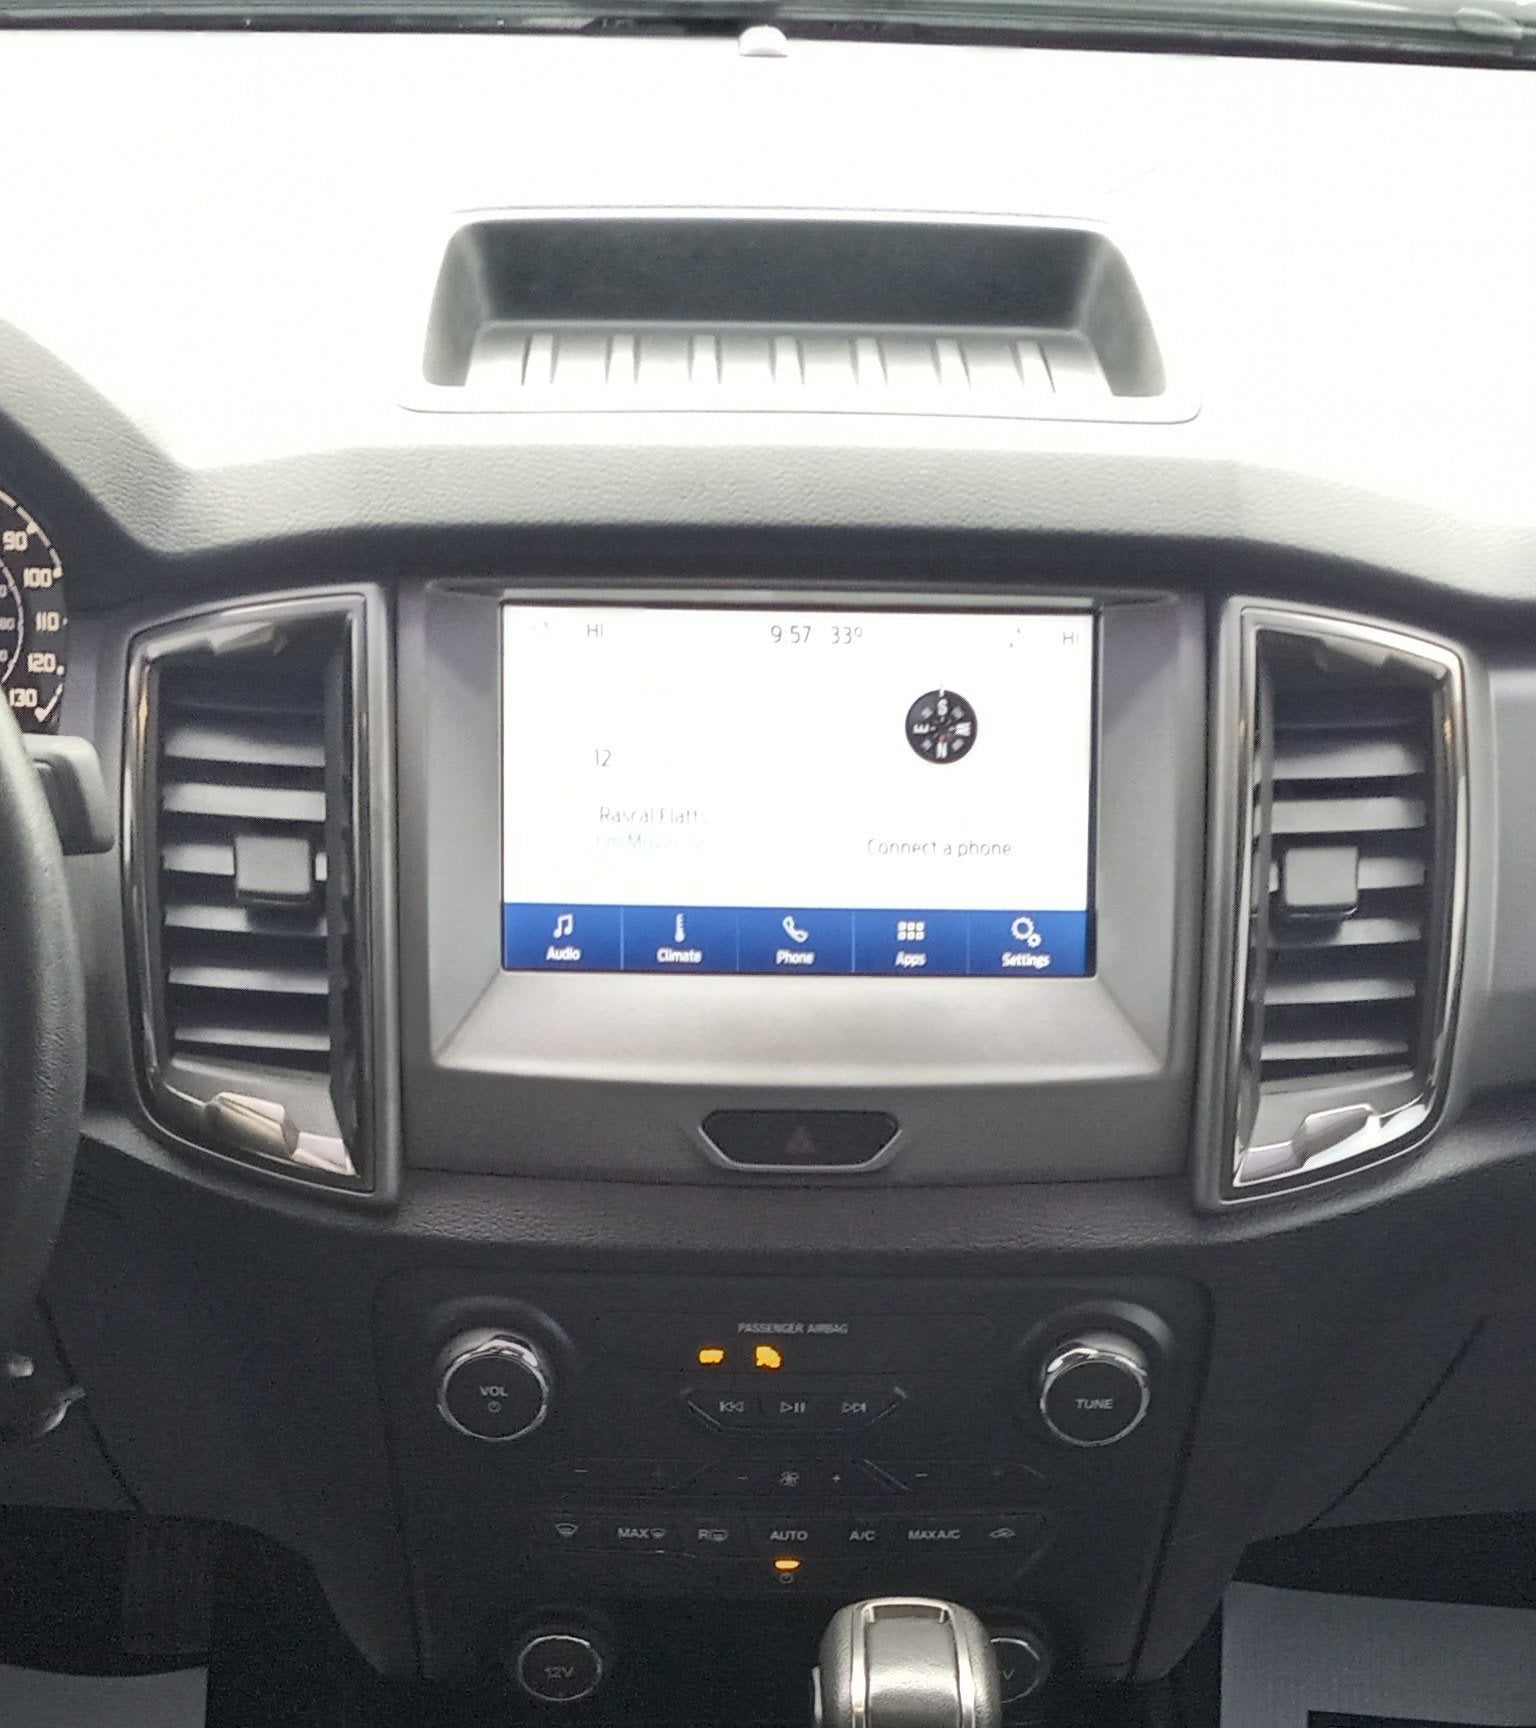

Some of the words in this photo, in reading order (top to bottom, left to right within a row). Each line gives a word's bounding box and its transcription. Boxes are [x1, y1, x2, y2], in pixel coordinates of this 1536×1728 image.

[2, 530, 29, 552] 90
[22, 567, 52, 588] 100
[35, 611, 60, 632] 110
[27, 652, 56, 673] 120
[10, 687, 37, 708] 130
[936, 697, 950, 717] S
[867, 838, 938, 857] Connect
[942, 841, 953, 857] a
[957, 839, 1013, 860] phone
[546, 945, 581, 963] Audio
[656, 947, 702, 965] Climate
[775, 948, 815, 966] Phone
[895, 950, 927, 969] Apps
[1002, 951, 1051, 970] Settings
[737, 1322, 804, 1334] PASSENGER
[479, 1386, 509, 1397] VOL
[1075, 1398, 1114, 1411] TUNE
[617, 1527, 650, 1540] MAX
[770, 1530, 809, 1541] AUTO
[849, 1529, 876, 1542] A/C
